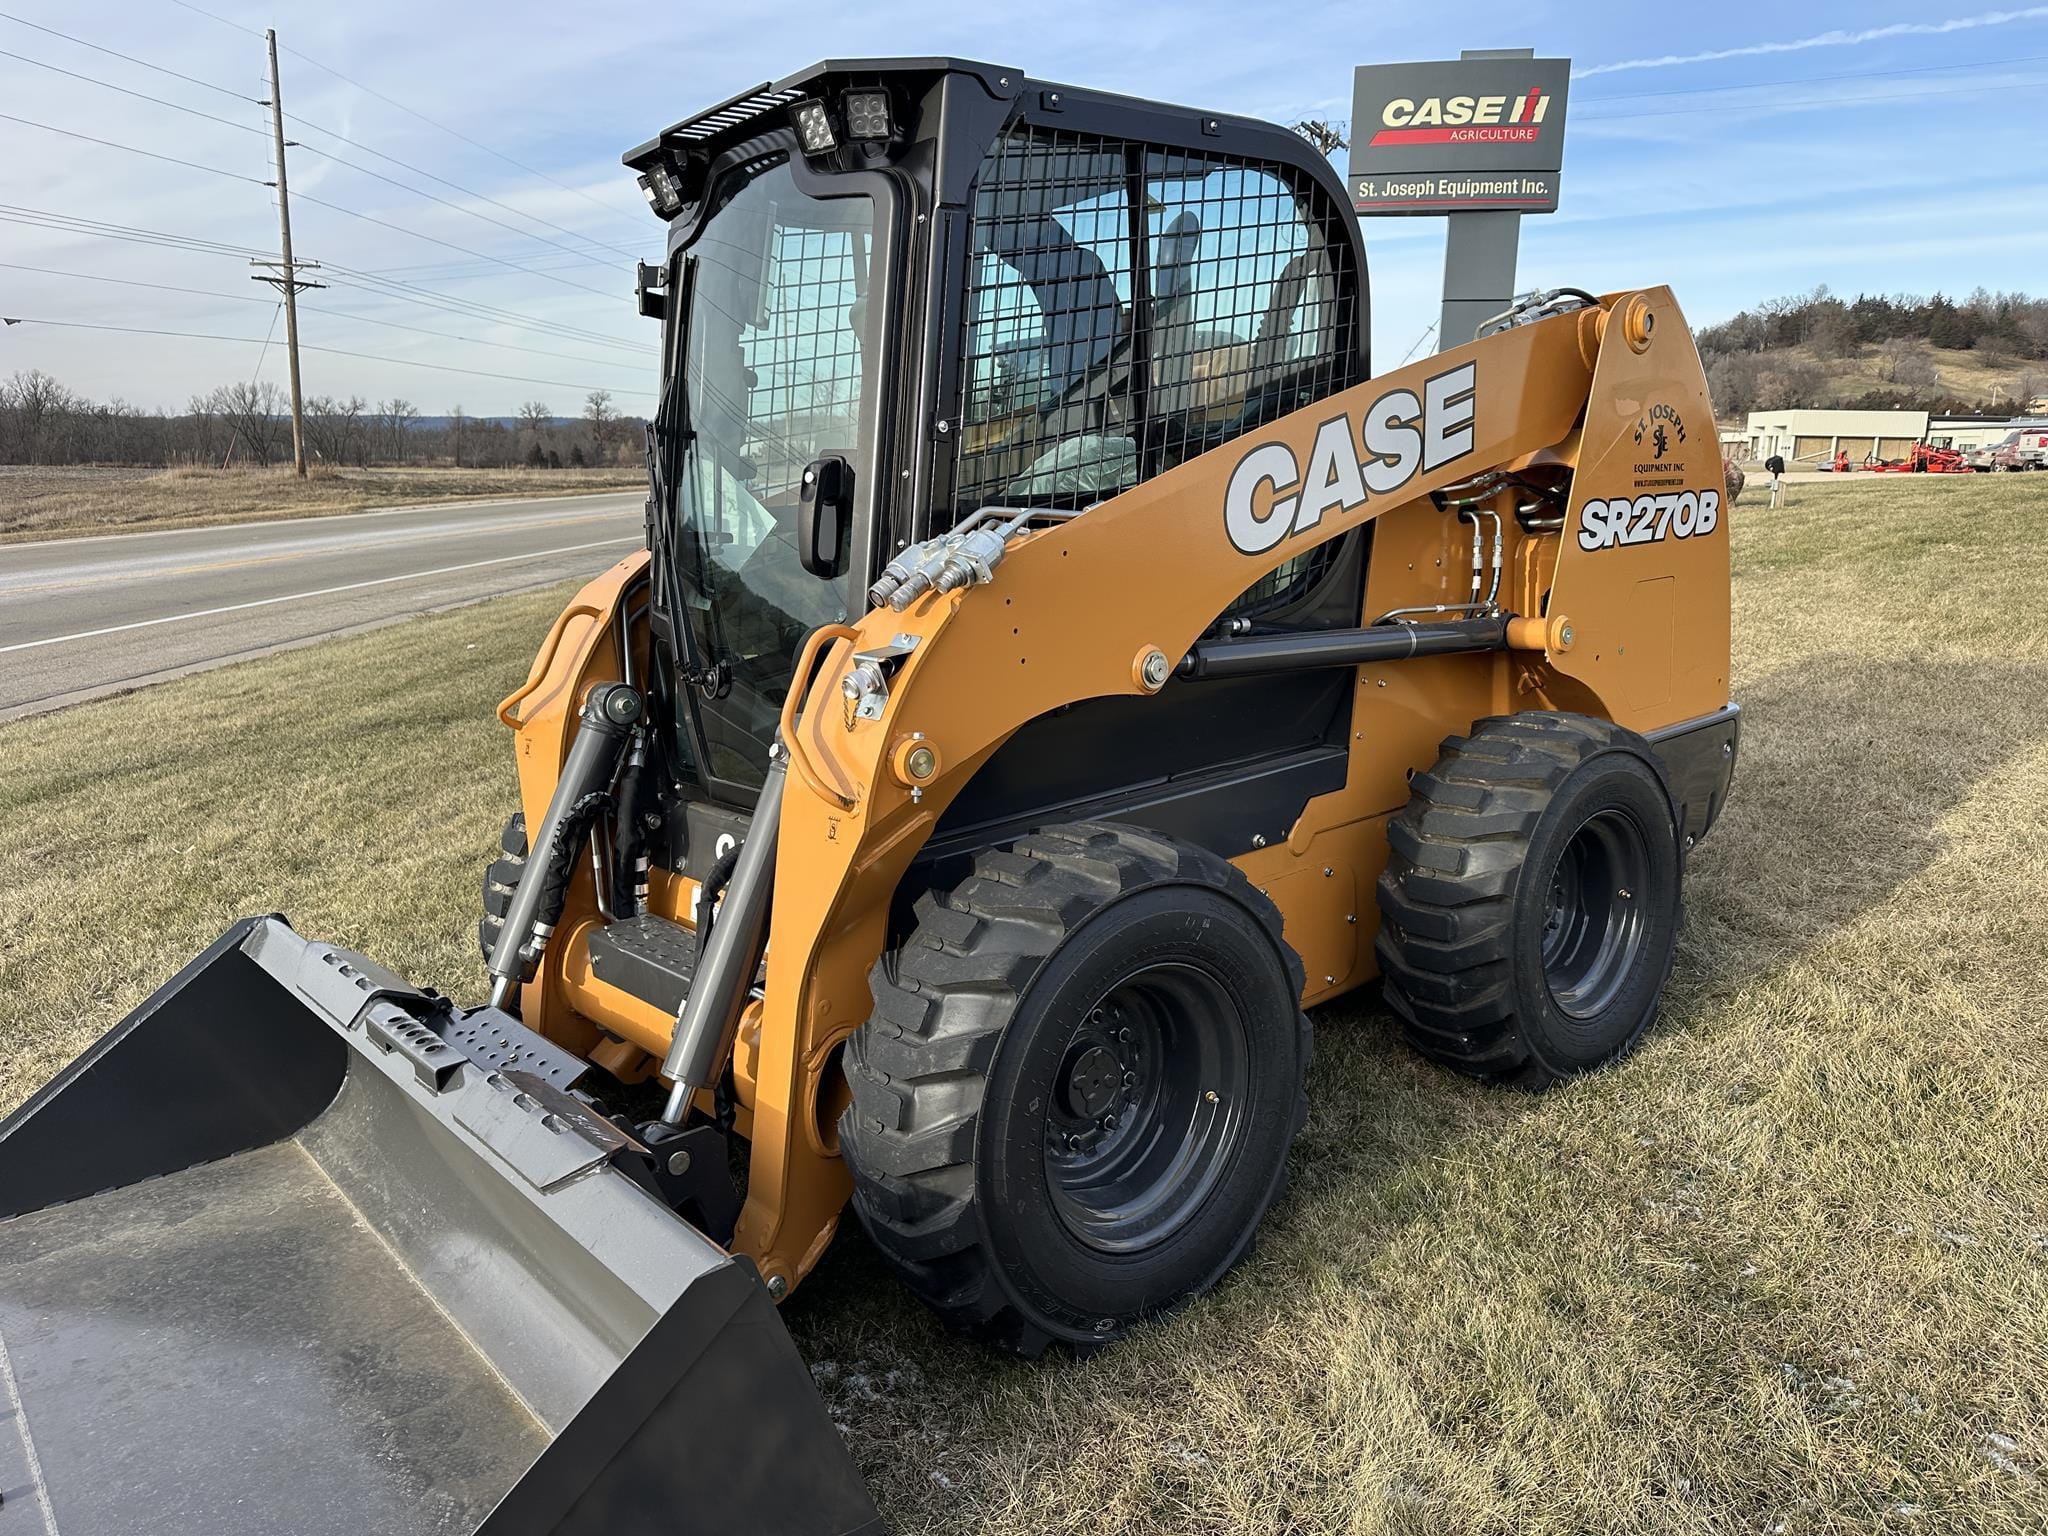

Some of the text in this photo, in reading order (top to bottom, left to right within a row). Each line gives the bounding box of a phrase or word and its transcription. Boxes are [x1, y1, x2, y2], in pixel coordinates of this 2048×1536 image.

[1382, 96, 1506, 127] CASE
[1450, 129, 1533, 141] AGRICULTURE
[1359, 178, 1549, 199] St. Joseph Equipment Inc.
[1648, 404, 1686, 444] JOSEPH
[1224, 360, 1477, 556] CASE
[1633, 463, 1685, 474] EQUIPMENT INC
[1578, 489, 1719, 552] SR270B
